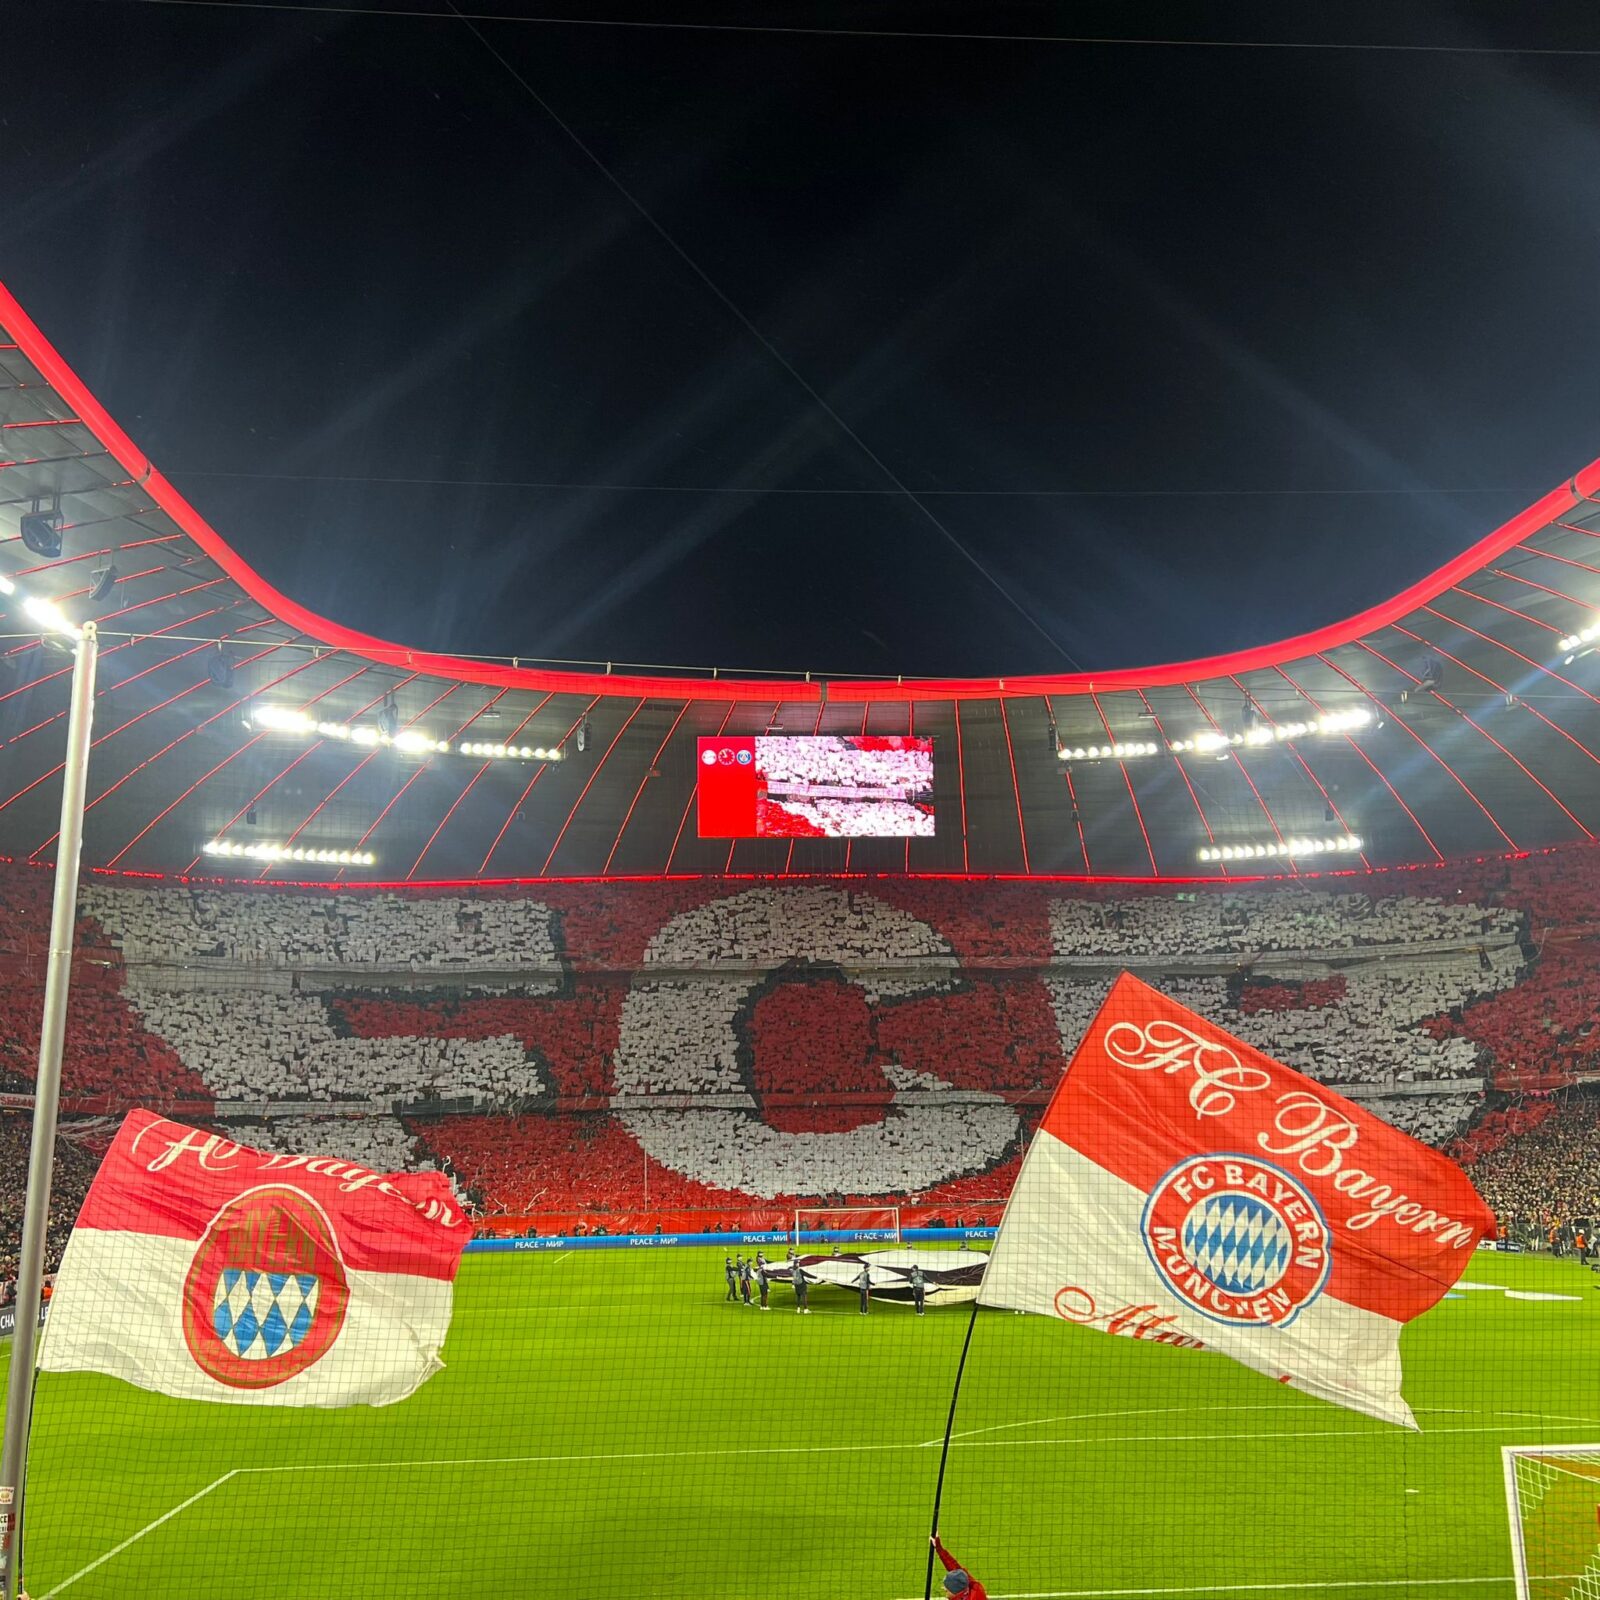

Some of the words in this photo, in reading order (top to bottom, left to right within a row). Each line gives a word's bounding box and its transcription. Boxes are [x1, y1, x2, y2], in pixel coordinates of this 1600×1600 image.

[1257, 1091, 1474, 1249] Bayern
[1172, 1165, 1216, 1204] FC
[1223, 1163, 1323, 1270] BAYERN
[630, 1237, 653, 1246] PEACE
[743, 1234, 766, 1243] PEACE
[514, 1240, 539, 1249] PEACE
